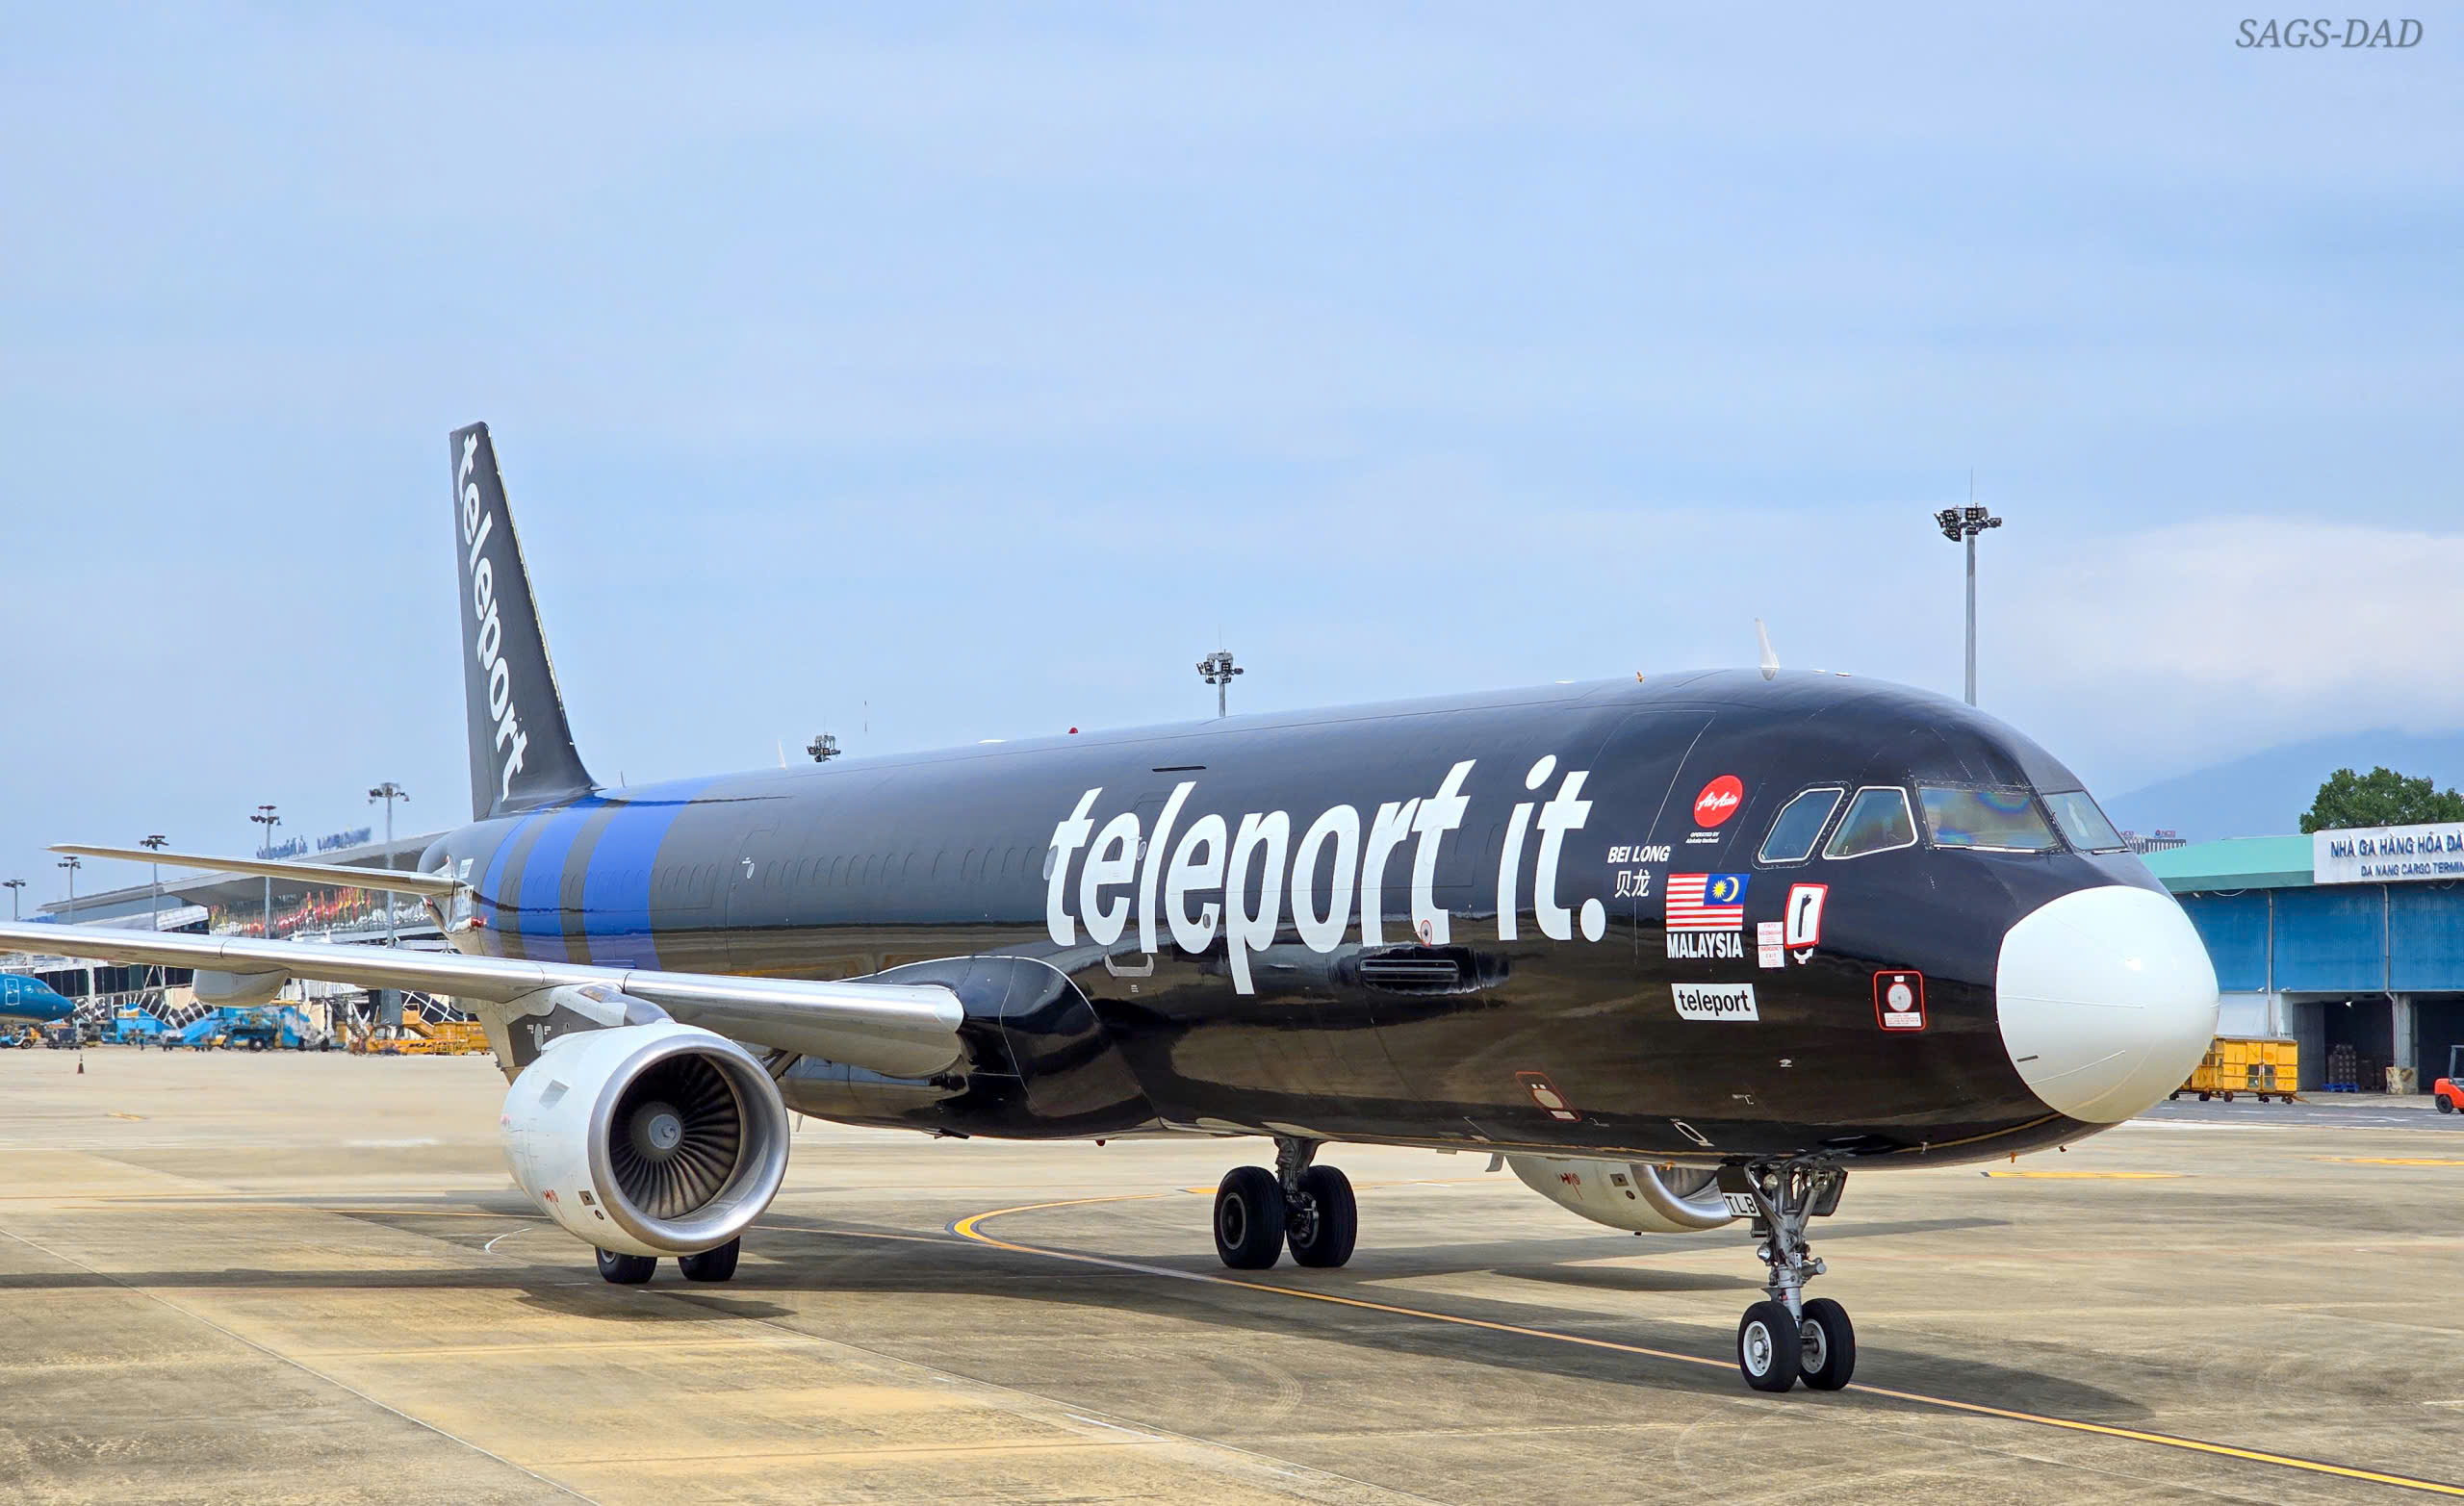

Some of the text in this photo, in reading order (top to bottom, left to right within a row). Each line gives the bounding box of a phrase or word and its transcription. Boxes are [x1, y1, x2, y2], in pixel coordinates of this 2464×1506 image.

[459, 433, 527, 802] teleport
[1607, 845, 1671, 863] BEI LONG
[2331, 835, 2357, 857] NHÀ
[2359, 838, 2377, 856] GA
[2380, 832, 2415, 855] HÀNG
[2418, 830, 2444, 854] HÓA
[1046, 754, 1606, 995] teleport it.
[1614, 868, 1651, 899] 贝龙
[2361, 865, 2374, 877] DA
[2375, 863, 2400, 876] NANG
[2401, 863, 2431, 876] CARGO
[1667, 932, 1744, 958] MALAYSIA
[1679, 989, 1751, 1016] teleport
[1725, 1196, 1757, 1214] TLB
